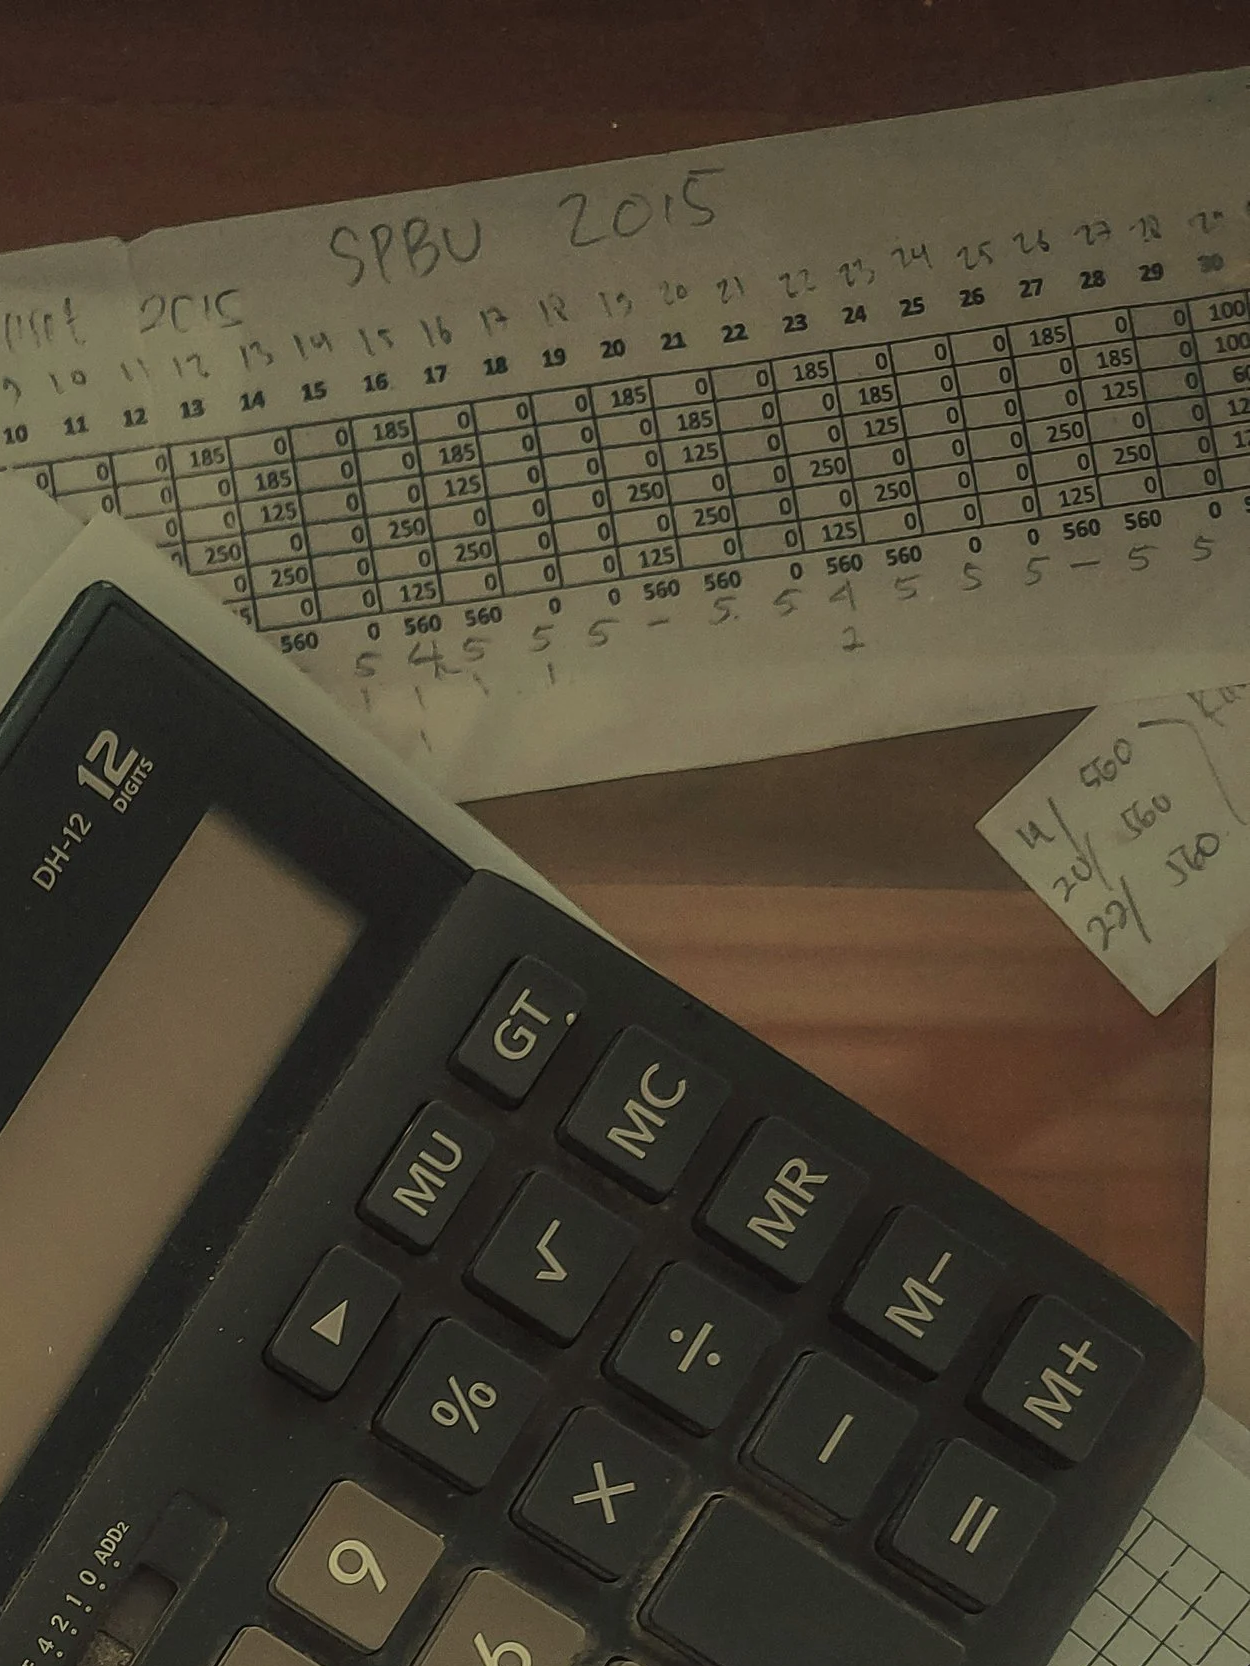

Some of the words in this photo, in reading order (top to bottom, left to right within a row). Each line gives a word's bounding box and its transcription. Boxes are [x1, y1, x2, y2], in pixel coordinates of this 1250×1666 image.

[328, 215, 481, 289] SPBU
[559, 167, 724, 247] 2015
[3, 424, 29, 444] 10
[63, 415, 89, 436] 11
[122, 408, 148, 428] 12
[240, 391, 266, 412] 14
[301, 381, 328, 401] 15
[363, 372, 389, 392] 16
[424, 365, 448, 384] 17
[484, 356, 509, 375] 18
[541, 348, 567, 368] 19
[600, 339, 626, 359] 20
[660, 332, 687, 352] 21
[722, 323, 748, 343] 22
[783, 314, 807, 333] 23
[842, 305, 867, 324] 24
[900, 297, 925, 317] 25
[959, 288, 985, 306] 26
[1019, 279, 1044, 298] 27
[1080, 269, 1106, 289] 28
[1138, 263, 1163, 282] 29
[886, 544, 922, 566] 560
[1062, 517, 1101, 541] 560
[1124, 509, 1162, 531] 560
[78, 728, 139, 800] 12
[113, 756, 154, 814] DIGITS
[32, 813, 92, 892] DH-12
[493, 987, 553, 1062] GT
[606, 1063, 688, 1160] MC
[391, 1128, 467, 1218] MU
[746, 1155, 829, 1250] MR
[431, 1378, 498, 1434] %
[1023, 1339, 1099, 1430] M+
[949, 1495, 1000, 1555] =
[327, 1538, 389, 1593] 9
[38, 1638, 54, 1655] 4
[50, 1614, 70, 1633] 2
